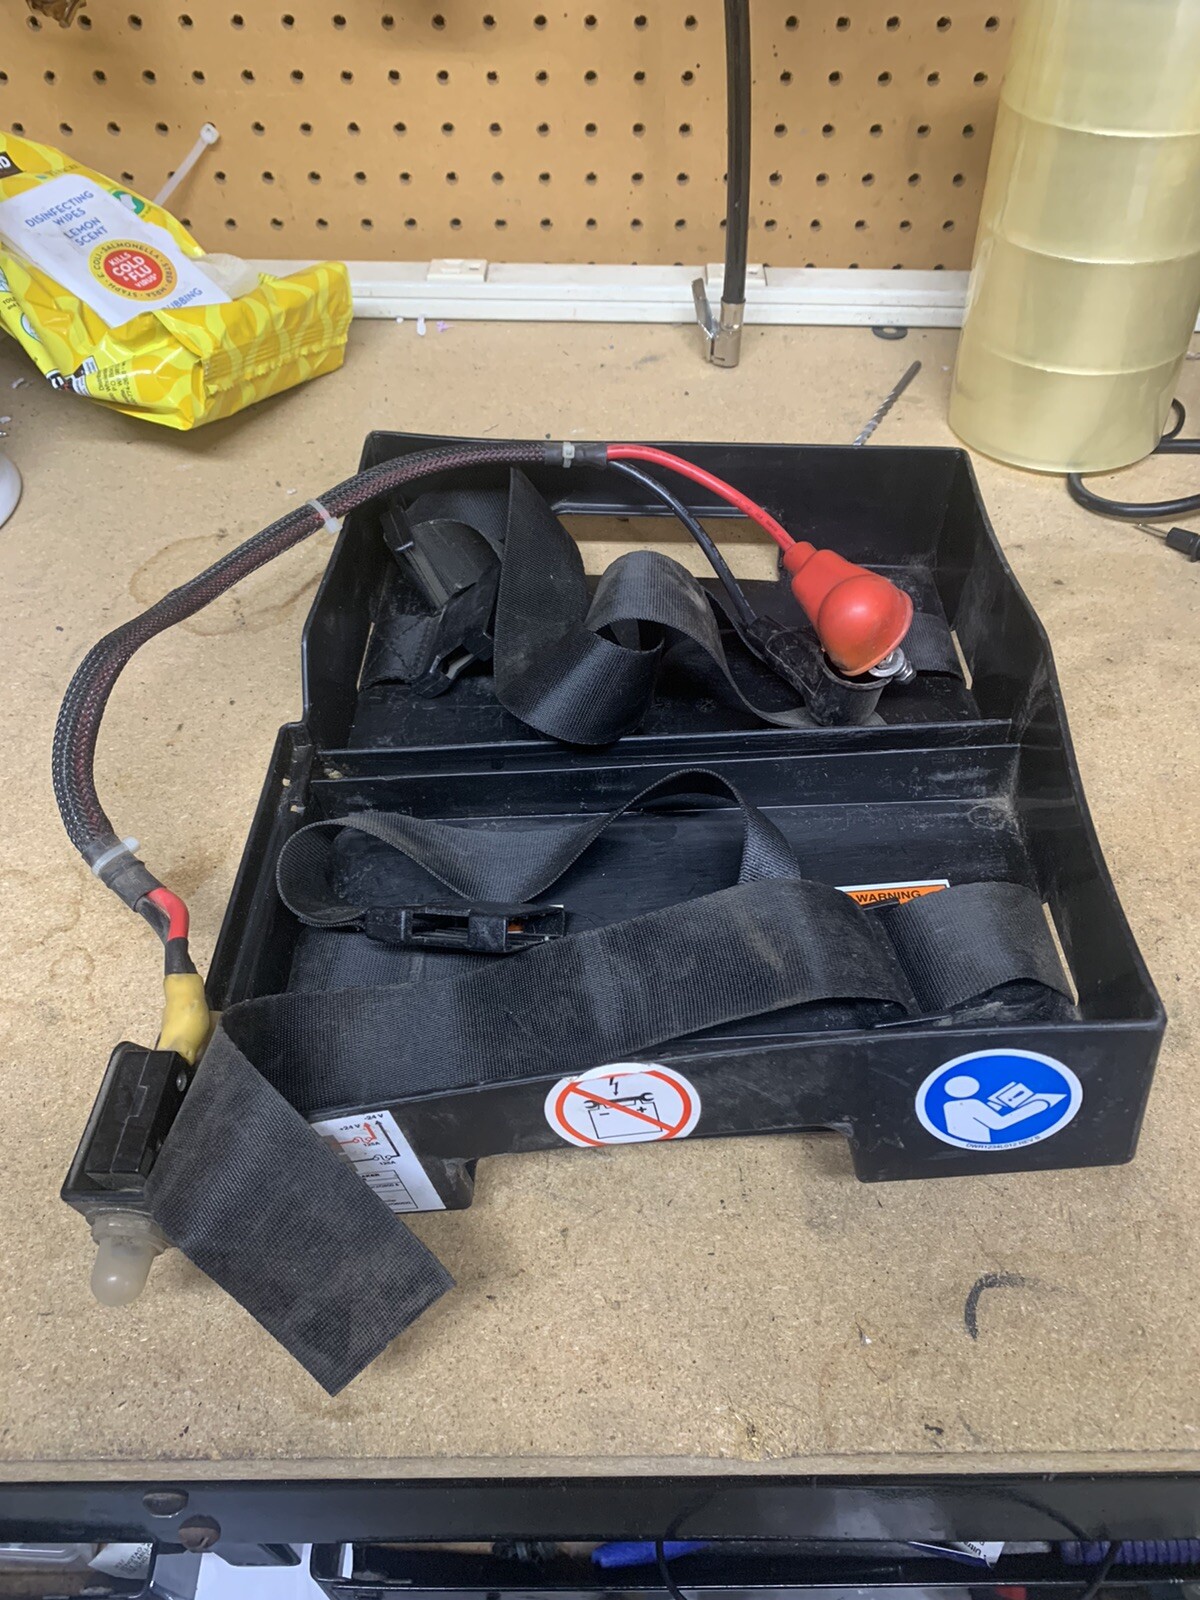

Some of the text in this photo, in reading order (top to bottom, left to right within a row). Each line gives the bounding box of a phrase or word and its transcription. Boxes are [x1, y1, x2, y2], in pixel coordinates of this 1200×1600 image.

[25, 190, 94, 228] DISINFECTING
[53, 207, 86, 226] WIPES
[63, 216, 101, 239] LEMON
[74, 225, 108, 246] SCENT
[102, 242, 159, 259] SALMONELLA
[108, 252, 132, 267] KILLS
[112, 255, 145, 277] COLD
[128, 264, 152, 281] FLU
[108, 282, 138, 298] STAPH
[161, 287, 204, 310] UBBING
[856, 890, 921, 902] WARNING
